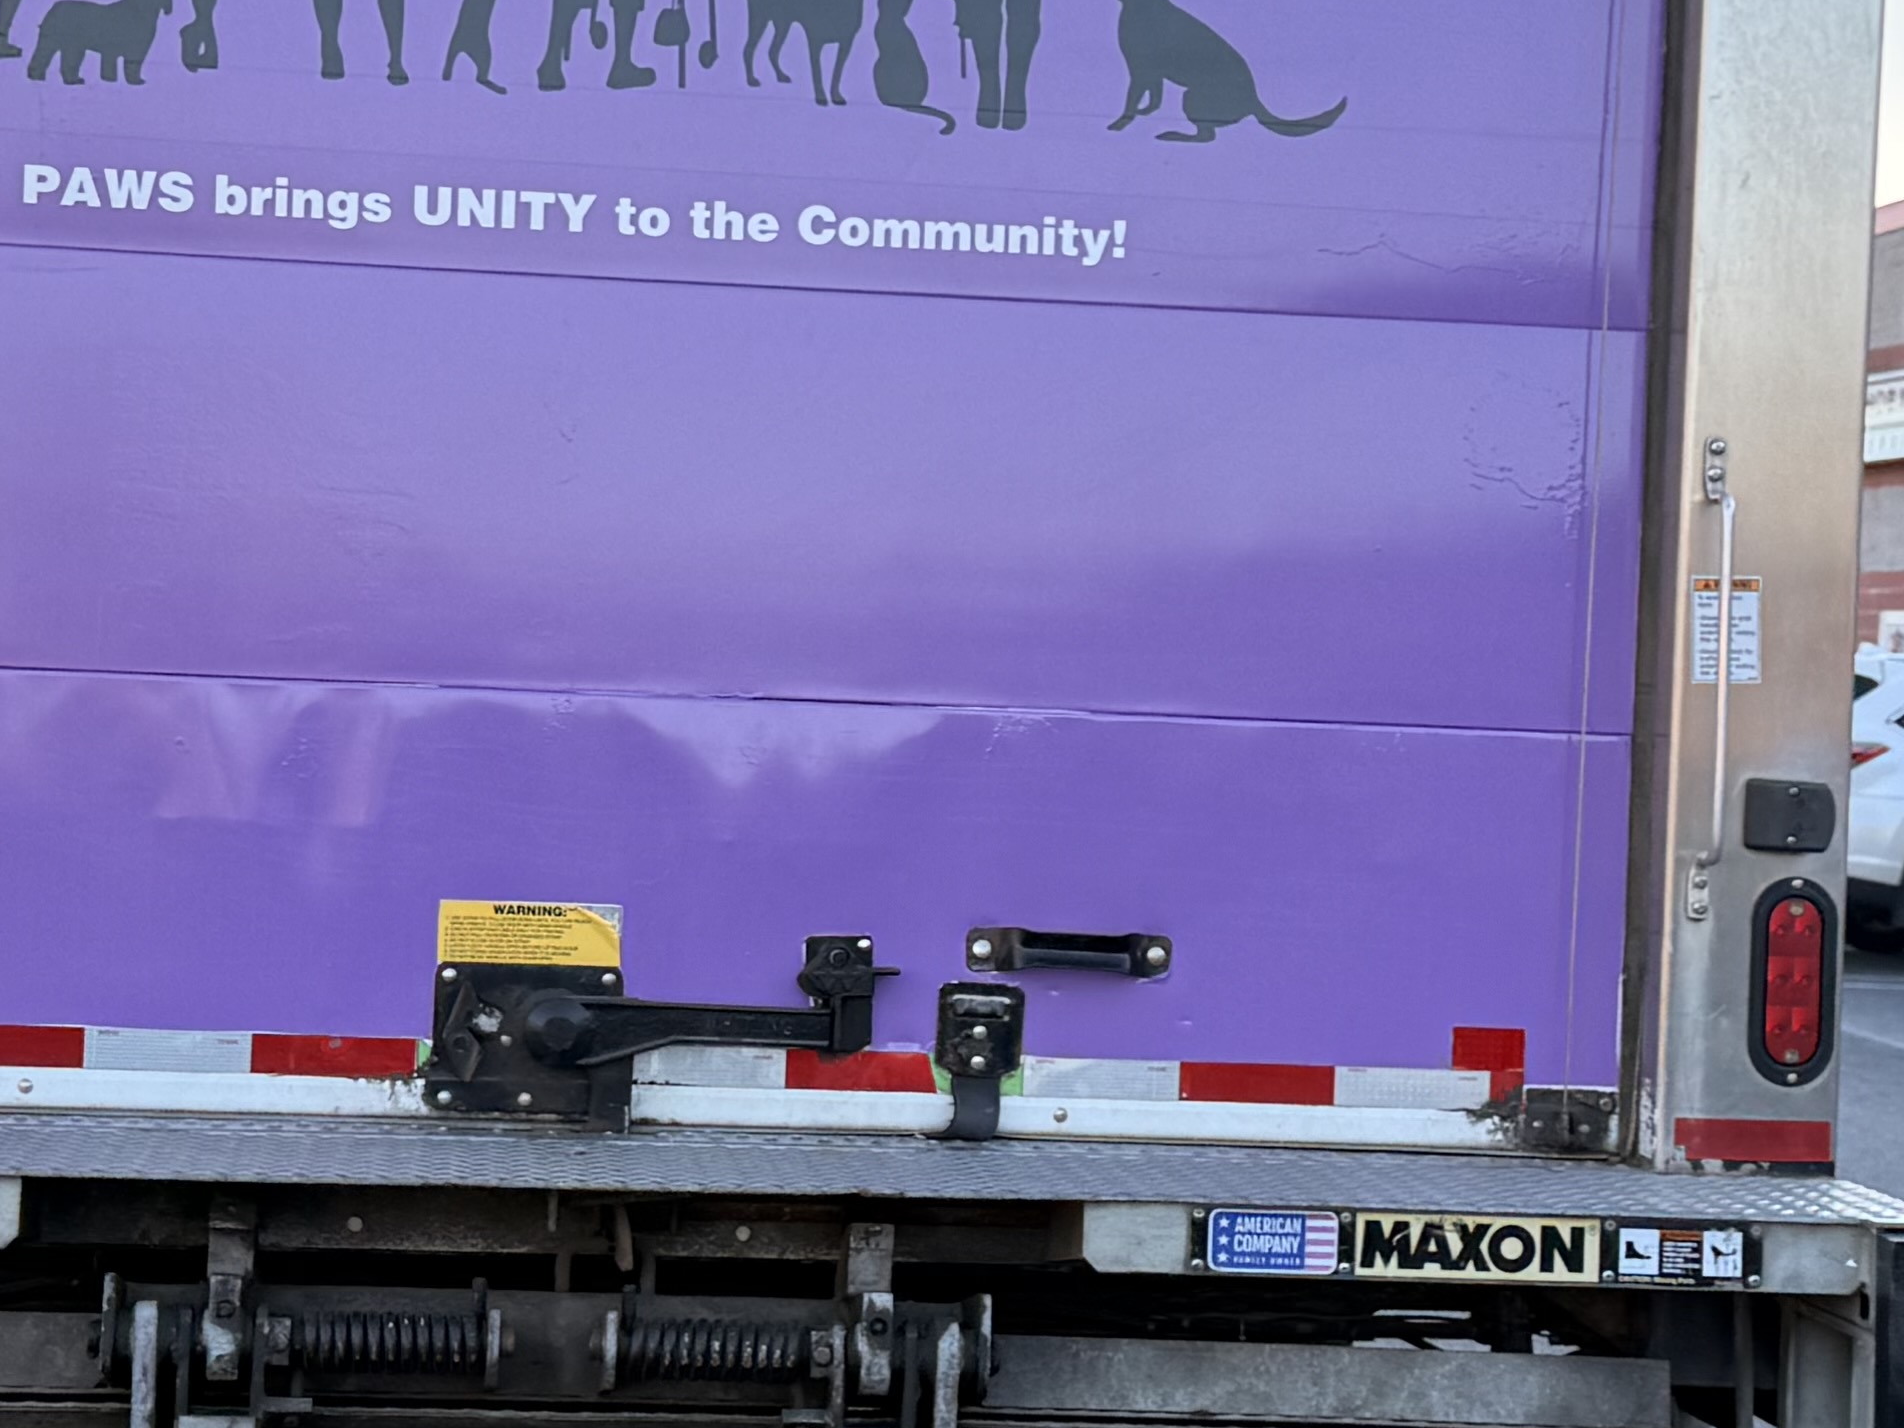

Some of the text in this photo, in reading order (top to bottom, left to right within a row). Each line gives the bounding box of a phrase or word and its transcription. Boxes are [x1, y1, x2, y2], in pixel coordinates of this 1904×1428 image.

[23, 164, 1127, 266] PAWS brings UNITY to the Community!
[492, 904, 568, 917] WARNING:
[1234, 1215, 1303, 1234] AMERICAN
[1233, 1233, 1301, 1254] COMPANY
[1359, 1219, 1585, 1274] MAXON
